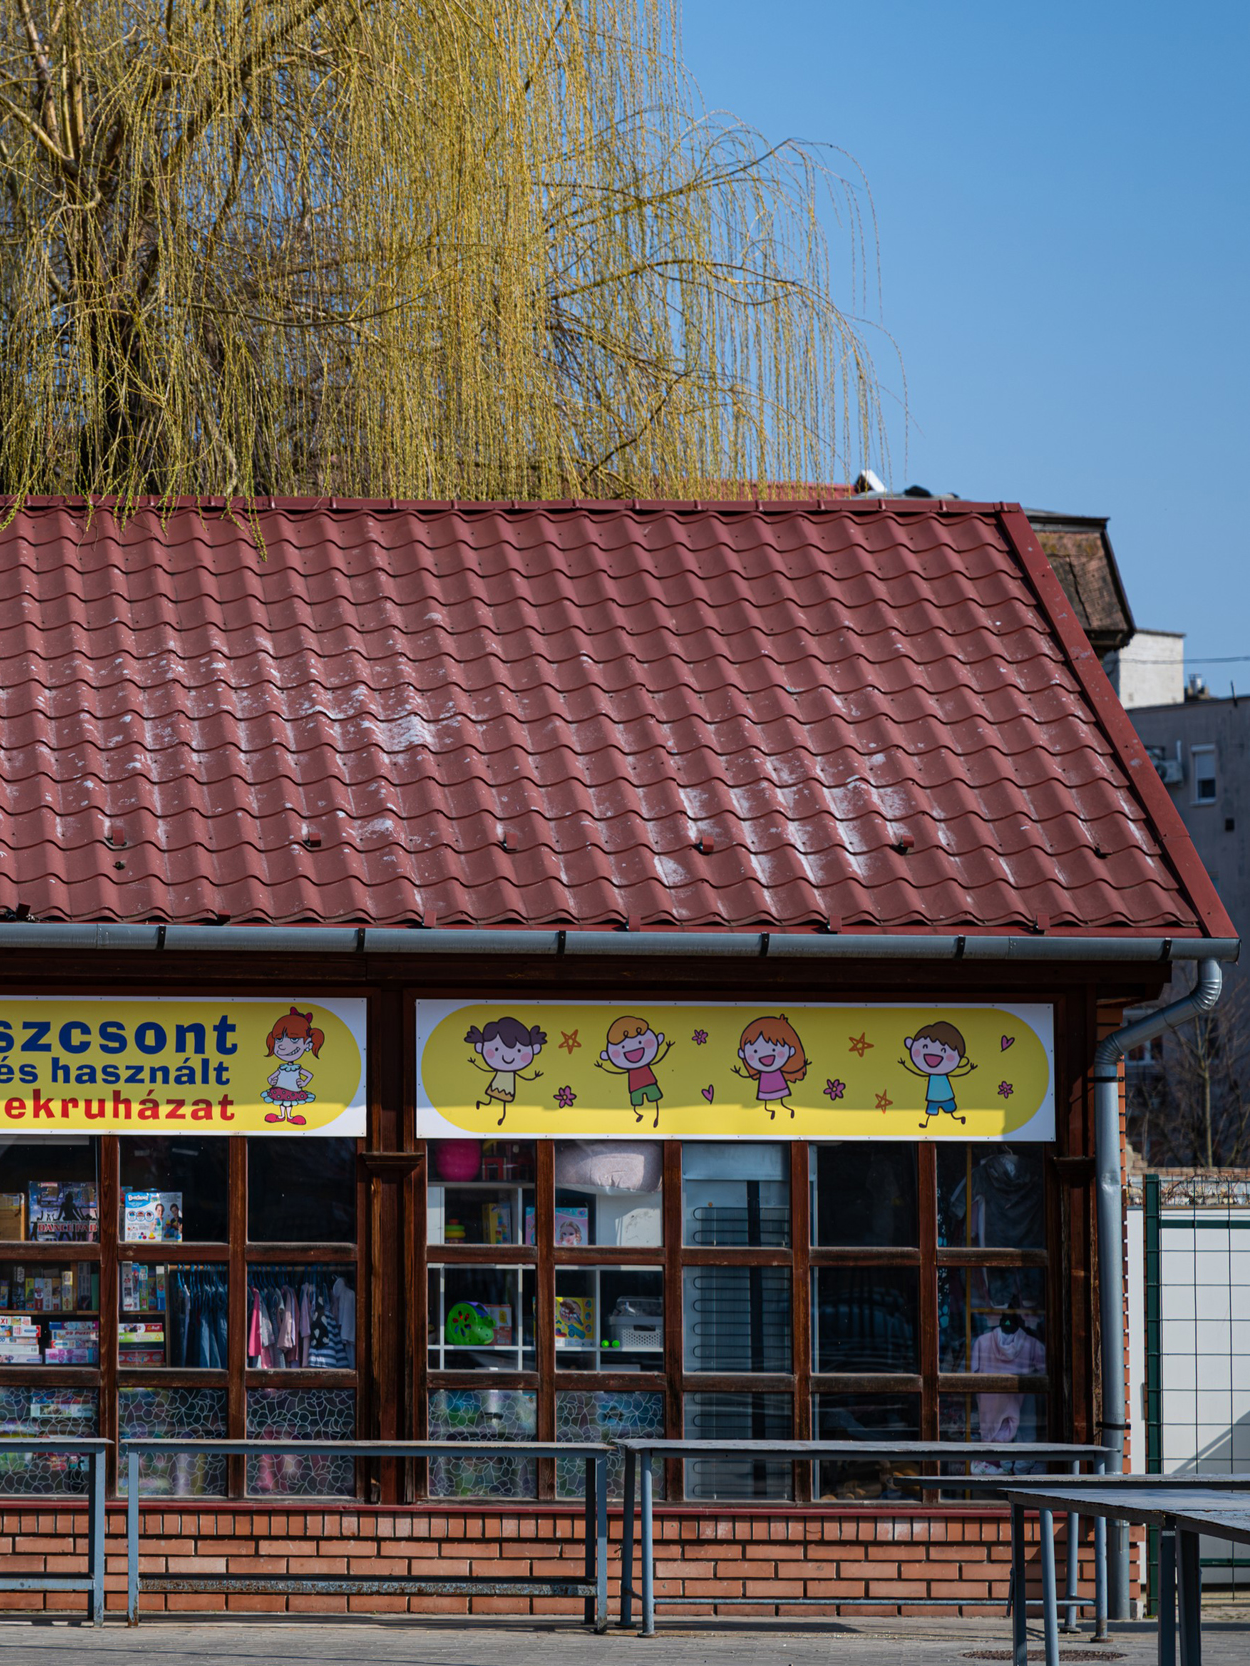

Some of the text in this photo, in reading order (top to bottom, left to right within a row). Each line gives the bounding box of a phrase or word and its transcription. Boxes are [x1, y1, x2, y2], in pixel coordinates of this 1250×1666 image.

[51, 1057, 231, 1086] használt
[38, 1223, 97, 1232] DANCE PAD
